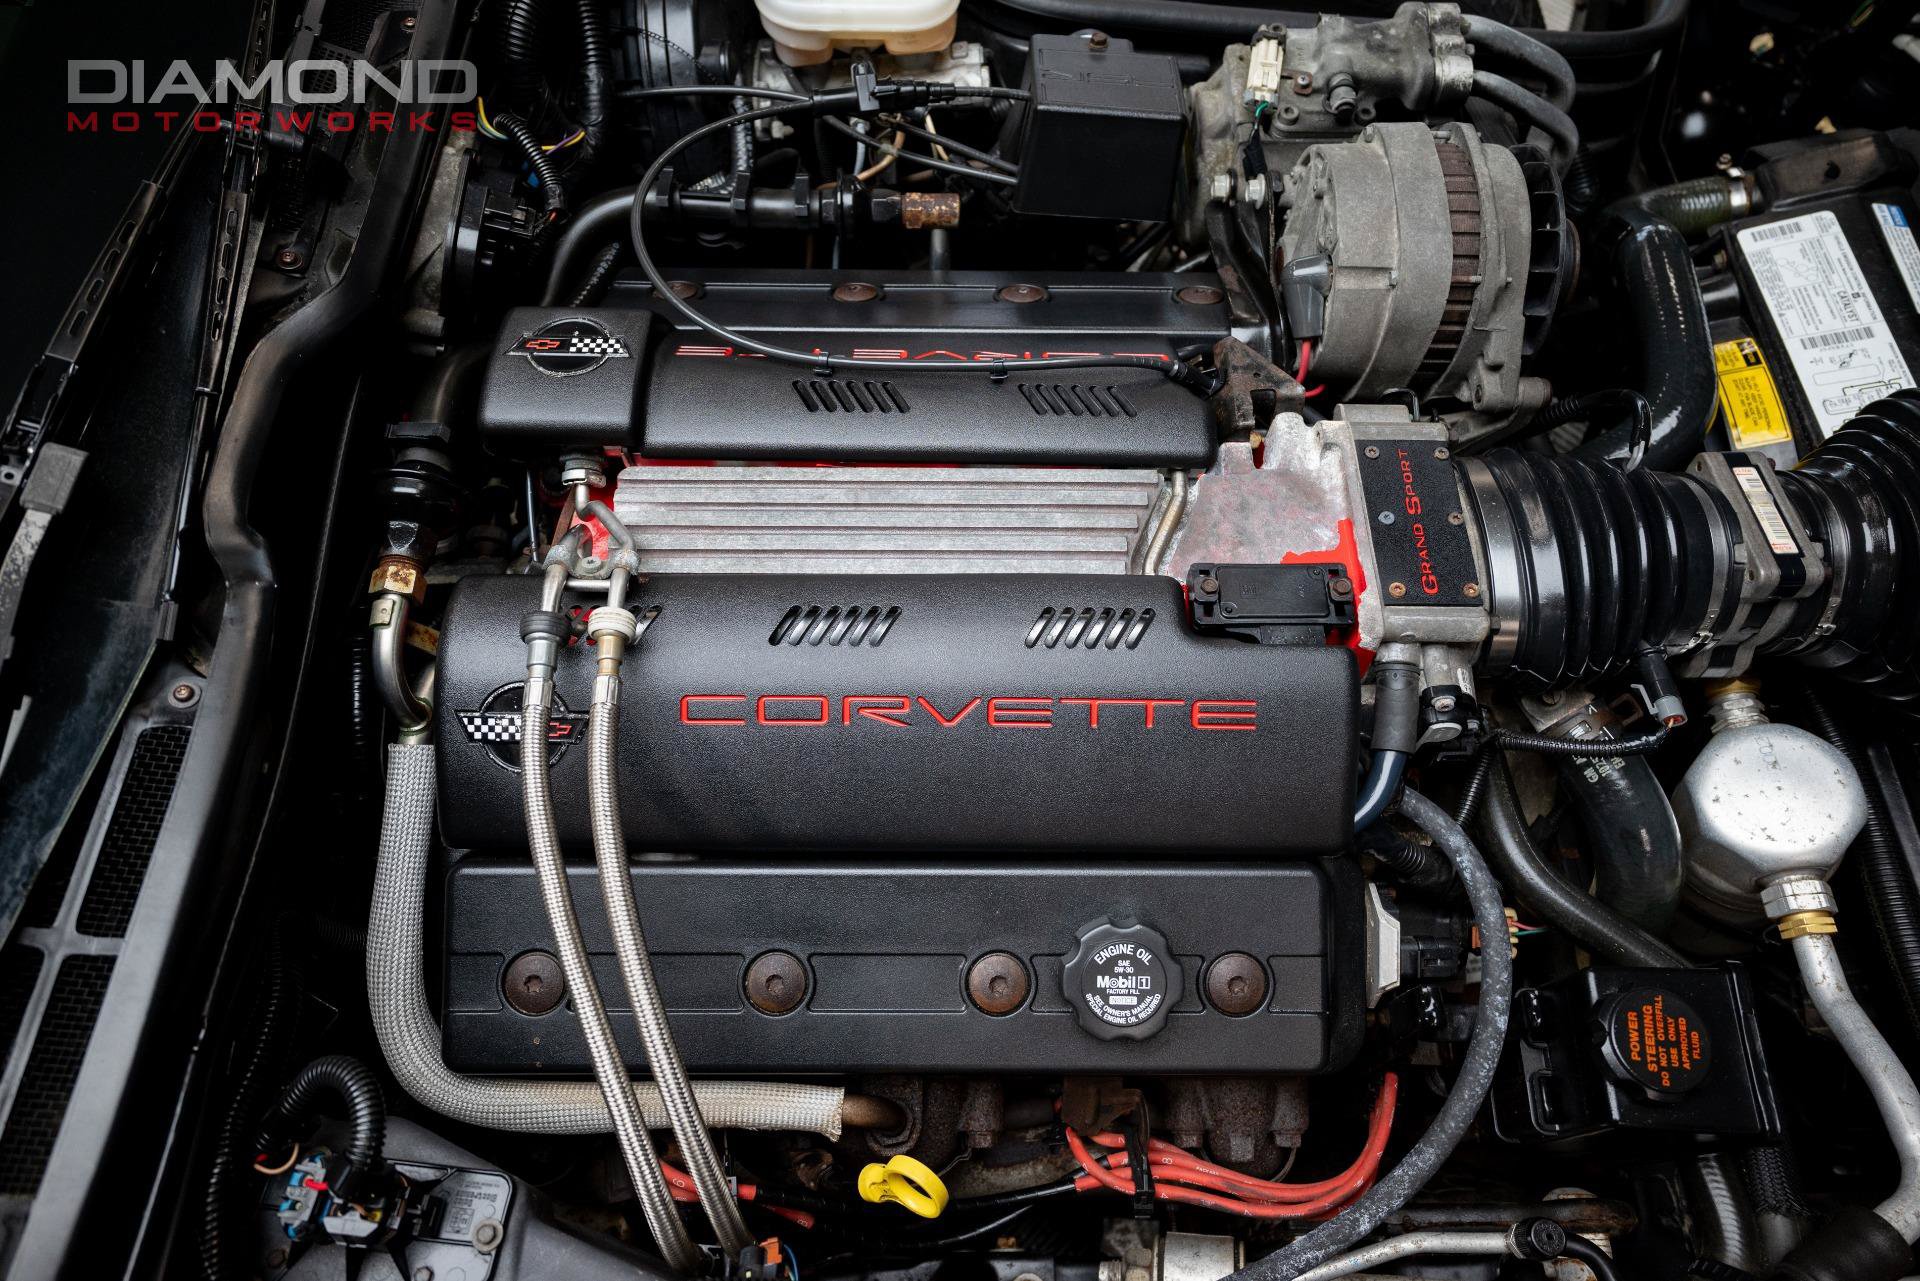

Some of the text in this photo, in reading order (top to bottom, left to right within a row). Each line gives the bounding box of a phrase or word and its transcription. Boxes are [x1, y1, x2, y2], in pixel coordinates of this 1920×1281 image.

[1837, 290, 1860, 322] CATALYST
[1397, 448, 1439, 595] GRAND SPORT
[680, 694, 1257, 730] CORVETTE
[1094, 943, 1152, 966] ENGINE OIL
[1096, 976, 1136, 989] Mobil
[1086, 993, 1161, 1024] SPECIAL ENGINE OIL REQUIRED
[1103, 1005, 1131, 1017] OWNER'S
[1131, 995, 1154, 1015] MANUAL
[1627, 1011, 1640, 1061] POWER
[1642, 1004, 1659, 1073] STEERING
[1654, 995, 1670, 1087] DO NOT OVERFILL
[1667, 1017, 1679, 1067] USE ONLY
[1678, 1018, 1691, 1070] APPROVED
[1690, 1031, 1701, 1060] FLUID
